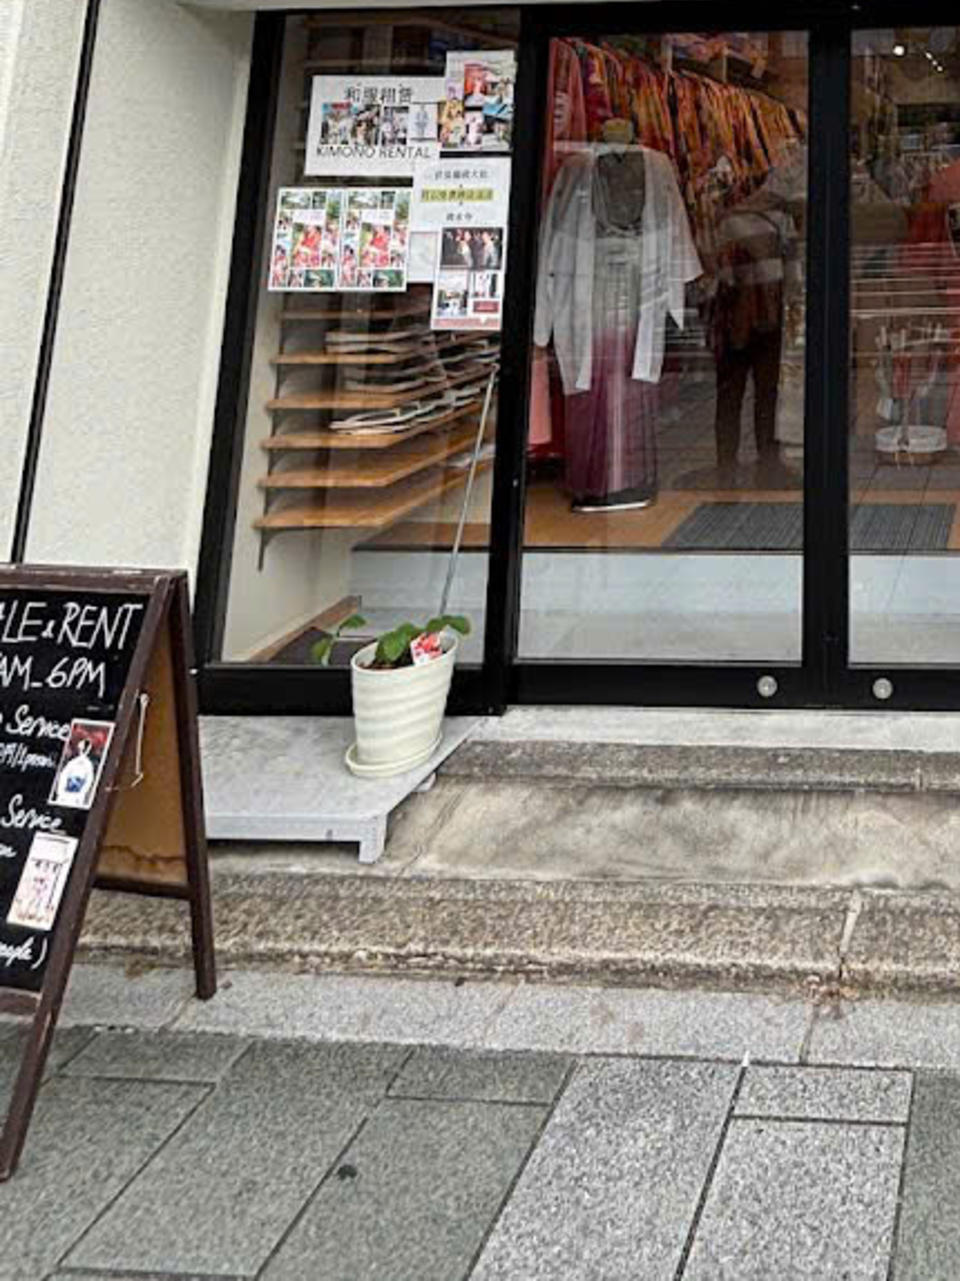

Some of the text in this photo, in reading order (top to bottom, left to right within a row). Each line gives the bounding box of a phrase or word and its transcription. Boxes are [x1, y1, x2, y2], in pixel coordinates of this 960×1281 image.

[316, 145, 432, 160] KIMONO RENTAL
[57, 601, 144, 651] RENT
